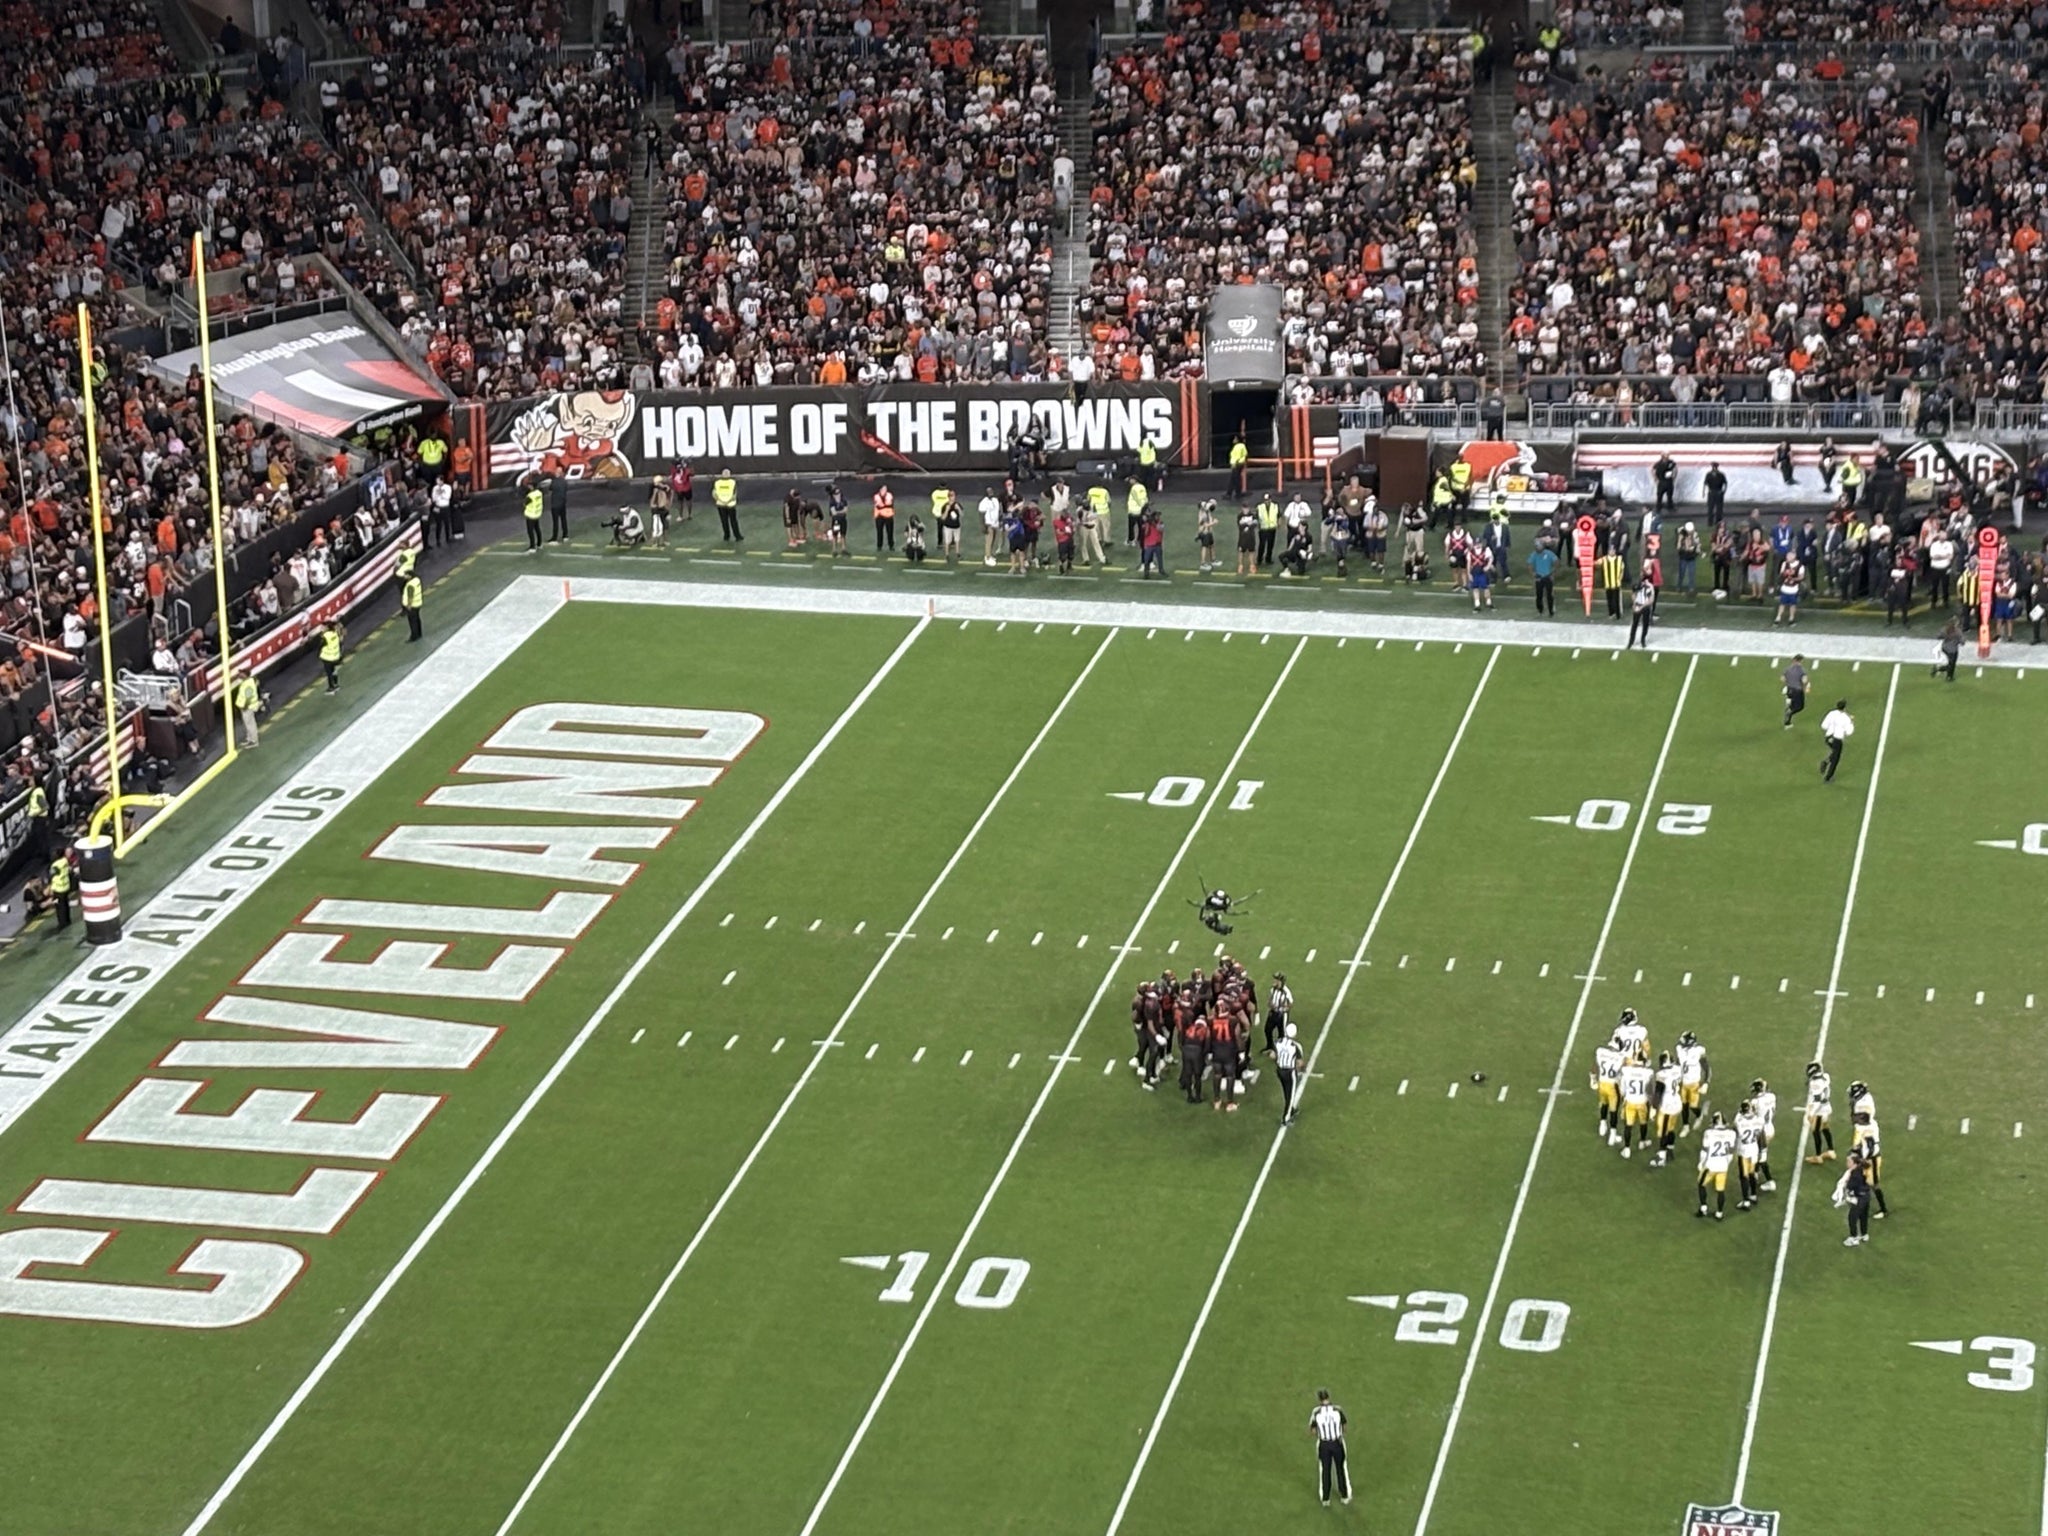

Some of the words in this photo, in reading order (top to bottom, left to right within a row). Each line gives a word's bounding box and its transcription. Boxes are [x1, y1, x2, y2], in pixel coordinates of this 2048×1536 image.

[213, 336, 319, 378] Huntington
[310, 325, 367, 345] Bank
[1211, 337, 1276, 347] University
[1213, 344, 1274, 353] Hospitals
[642, 402, 782, 459] HOME
[789, 400, 849, 457] OF
[867, 398, 958, 454] THE
[130, 886, 244, 947] ALL
[209, 834, 287, 872] OF
[262, 785, 347, 823] US
[0, 700, 770, 1329] CLEVELAND
[1213, 1022, 1232, 1042] 71
[1600, 1060, 1618, 1079] 56
[1629, 1079, 1644, 1095] 51
[1710, 1140, 1731, 1158] 23
[1966, 1335, 2037, 1393] 3
